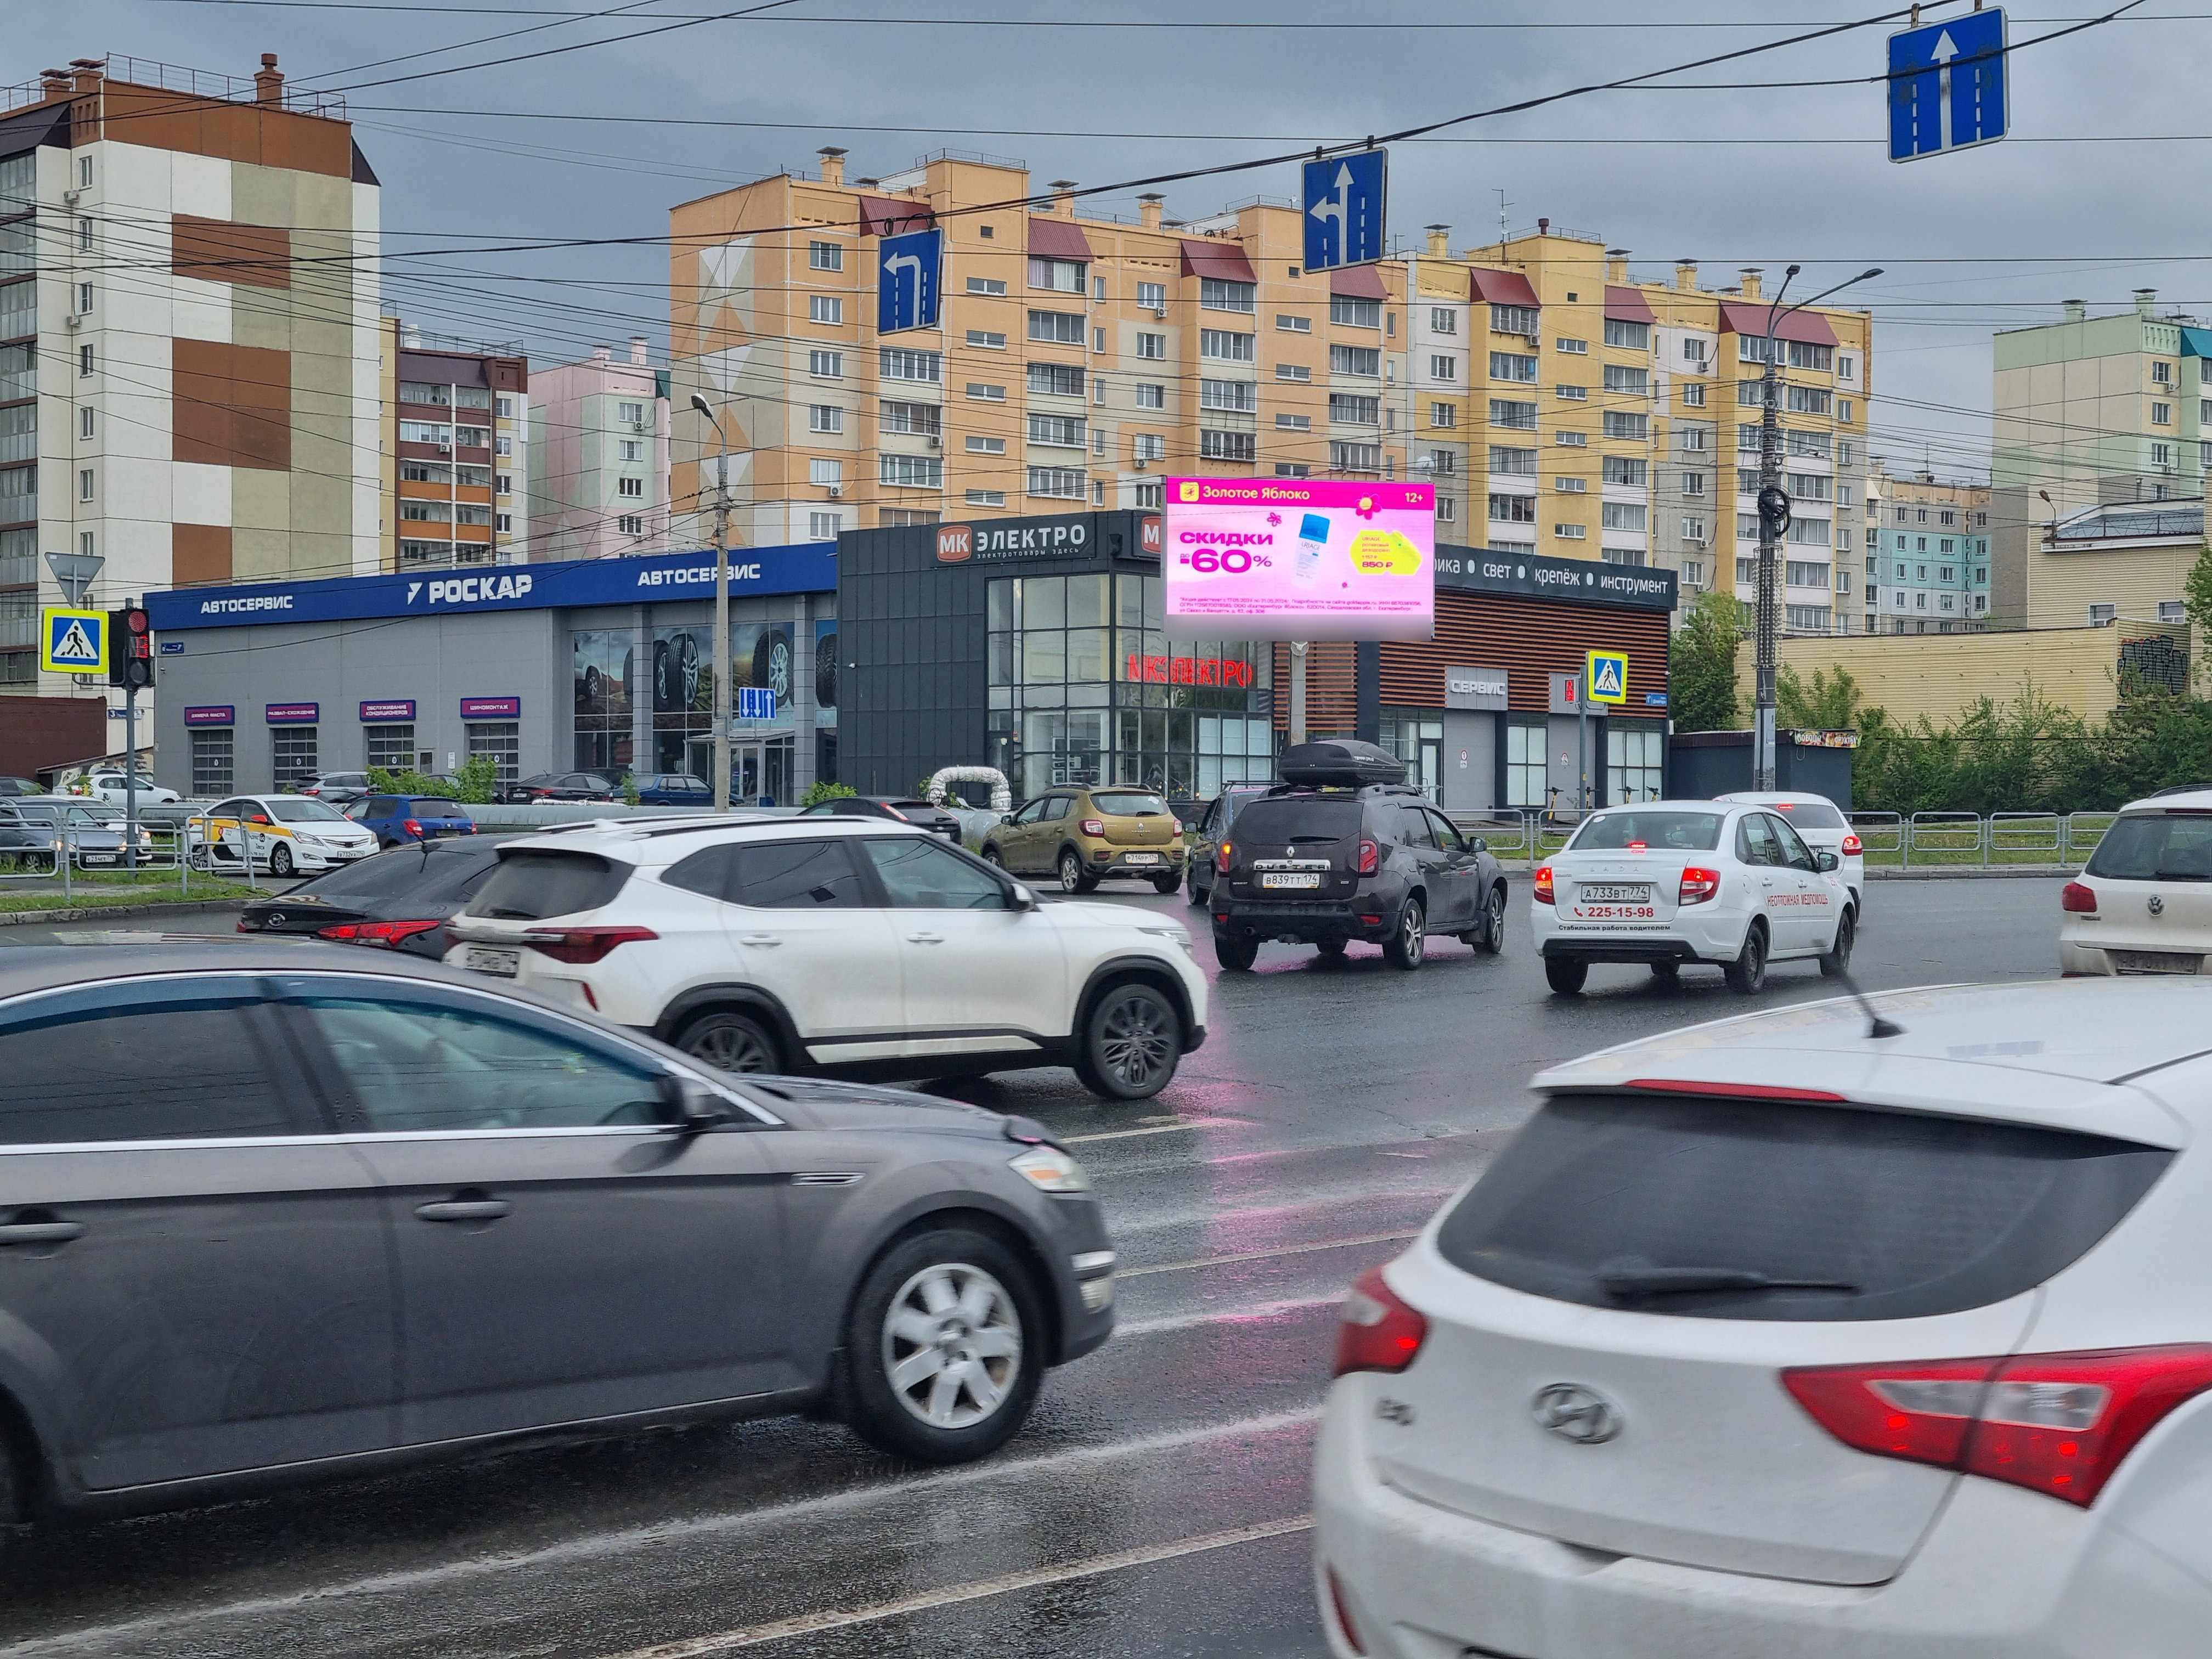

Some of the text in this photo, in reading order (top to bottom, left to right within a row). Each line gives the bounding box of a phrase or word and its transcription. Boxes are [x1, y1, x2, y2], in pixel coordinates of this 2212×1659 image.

[1203, 486, 1258, 498] Золотое
[1261, 487, 1310, 500] Яблоко
[1404, 492, 1424, 503] 12+
[940, 524, 1085, 554] МК ЭЛЕКТРО
[977, 549, 1046, 559] электротовары
[637, 564, 761, 586] АВТОСЕРВИС
[1483, 563, 1511, 579] свет
[1535, 567, 1580, 586] крепёж
[1601, 574, 1668, 595] инструмент
[429, 574, 521, 604] РОСКАР
[201, 595, 293, 614] АВТОСЕРВИС
[1451, 680, 1505, 695] СЕРВИС
[1266, 874, 1317, 885] В839ТТ 174
[1585, 887, 1646, 899] А733ВТ 774
[1588, 907, 1654, 918] 225-15-98
